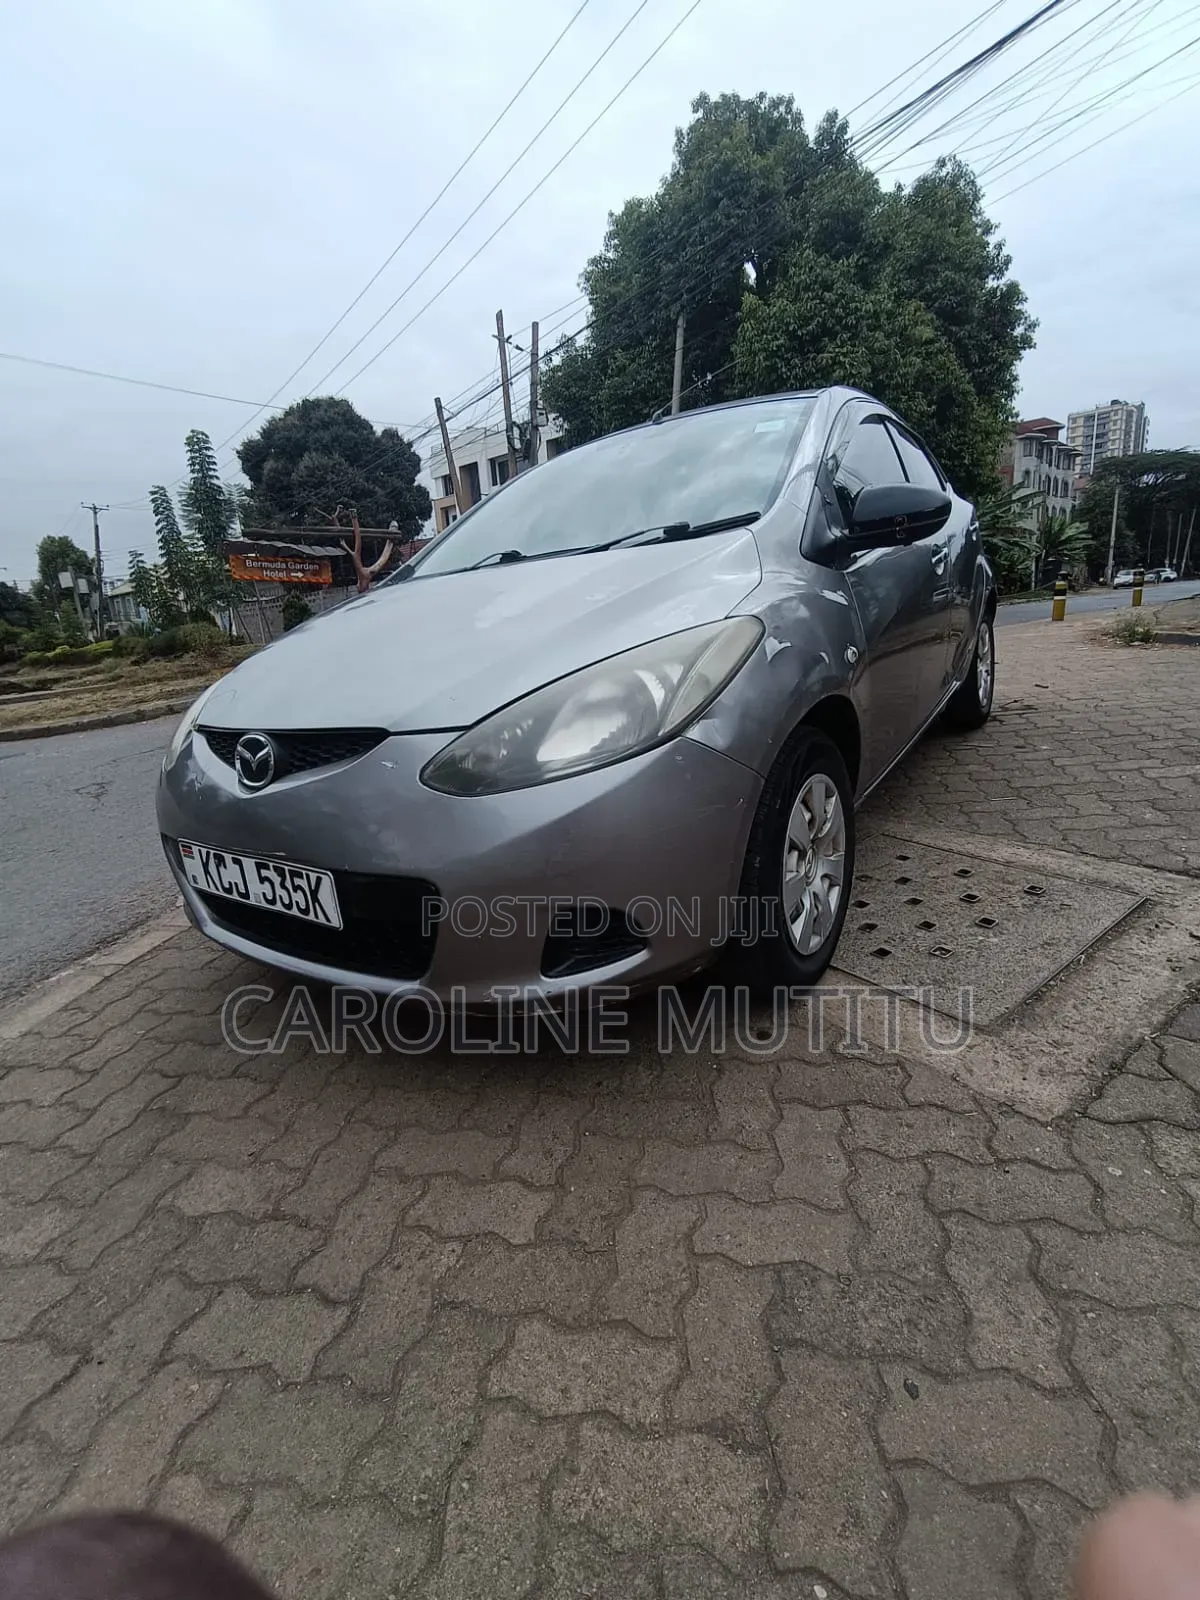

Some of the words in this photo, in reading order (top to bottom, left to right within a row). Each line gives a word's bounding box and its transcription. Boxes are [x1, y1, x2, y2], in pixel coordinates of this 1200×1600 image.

[245, 559, 286, 569] Bermuda
[288, 562, 319, 570] Garden
[263, 570, 287, 578] Hotel
[198, 849, 250, 900] KCJ
[254, 860, 331, 924] 535K
